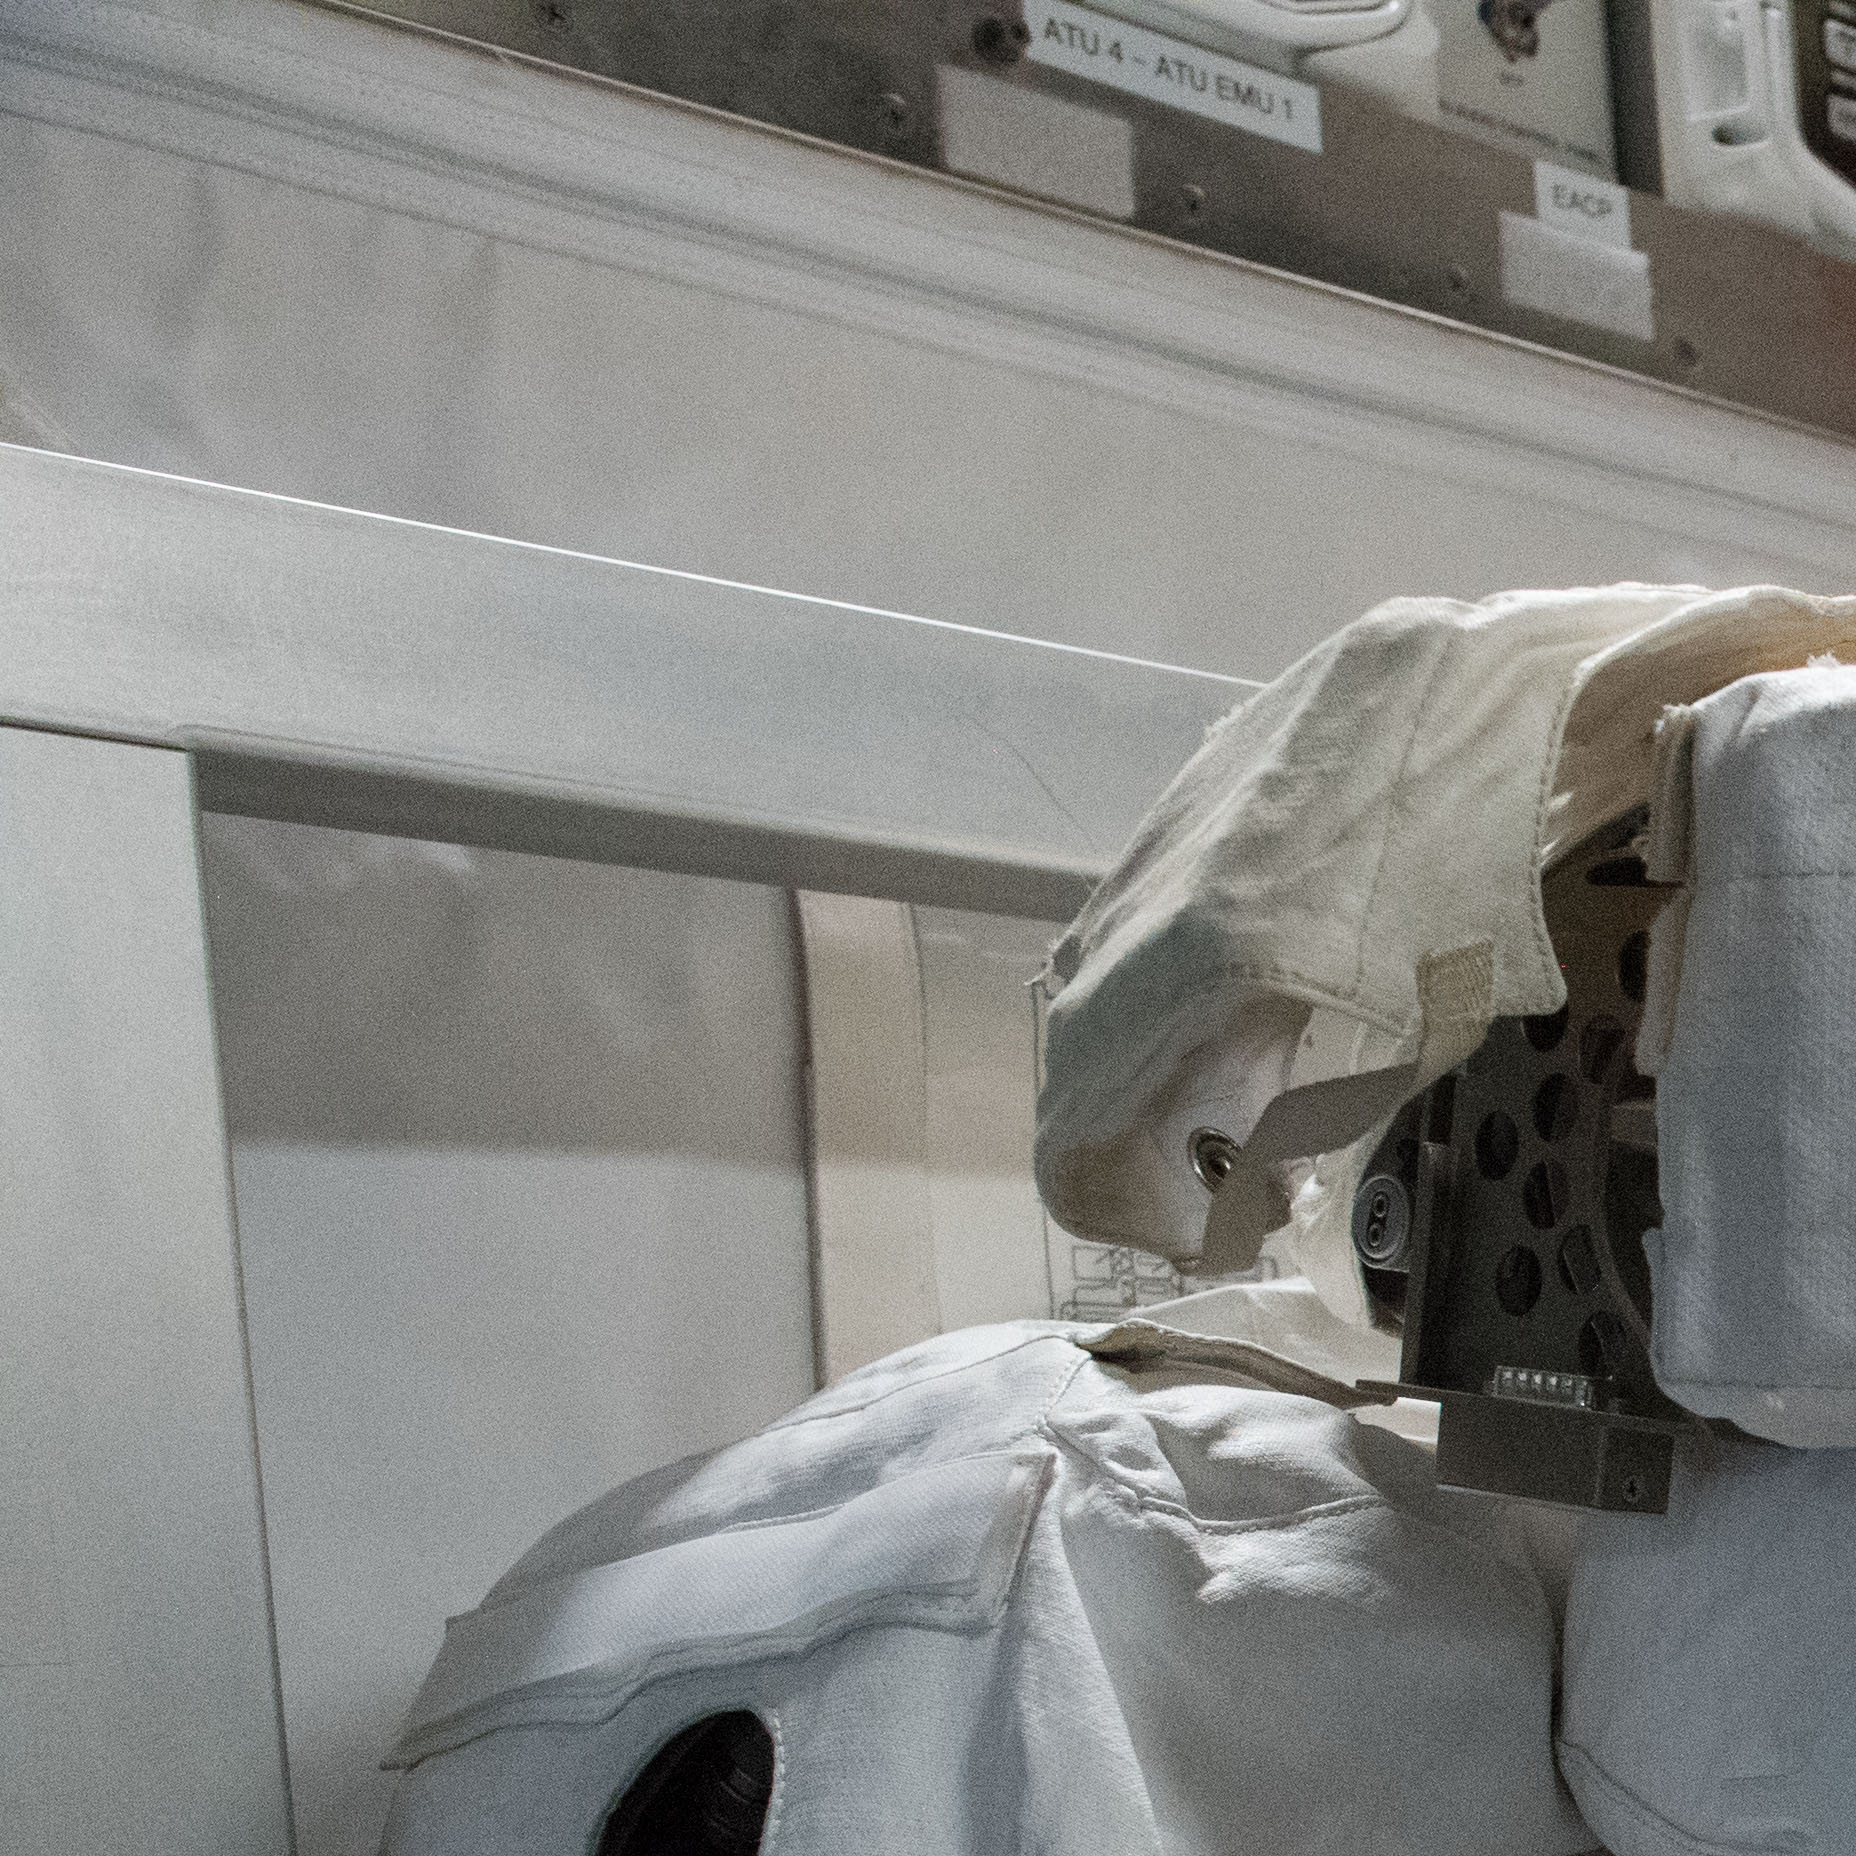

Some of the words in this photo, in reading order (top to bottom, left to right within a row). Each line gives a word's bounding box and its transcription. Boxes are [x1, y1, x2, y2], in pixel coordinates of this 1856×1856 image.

[1043, 17, 1101, 57] ATU
[1107, 39, 1125, 65] 4
[1154, 53, 1209, 94] ATU
[1214, 73, 1276, 116] EMU
[1281, 96, 1295, 121] 1
